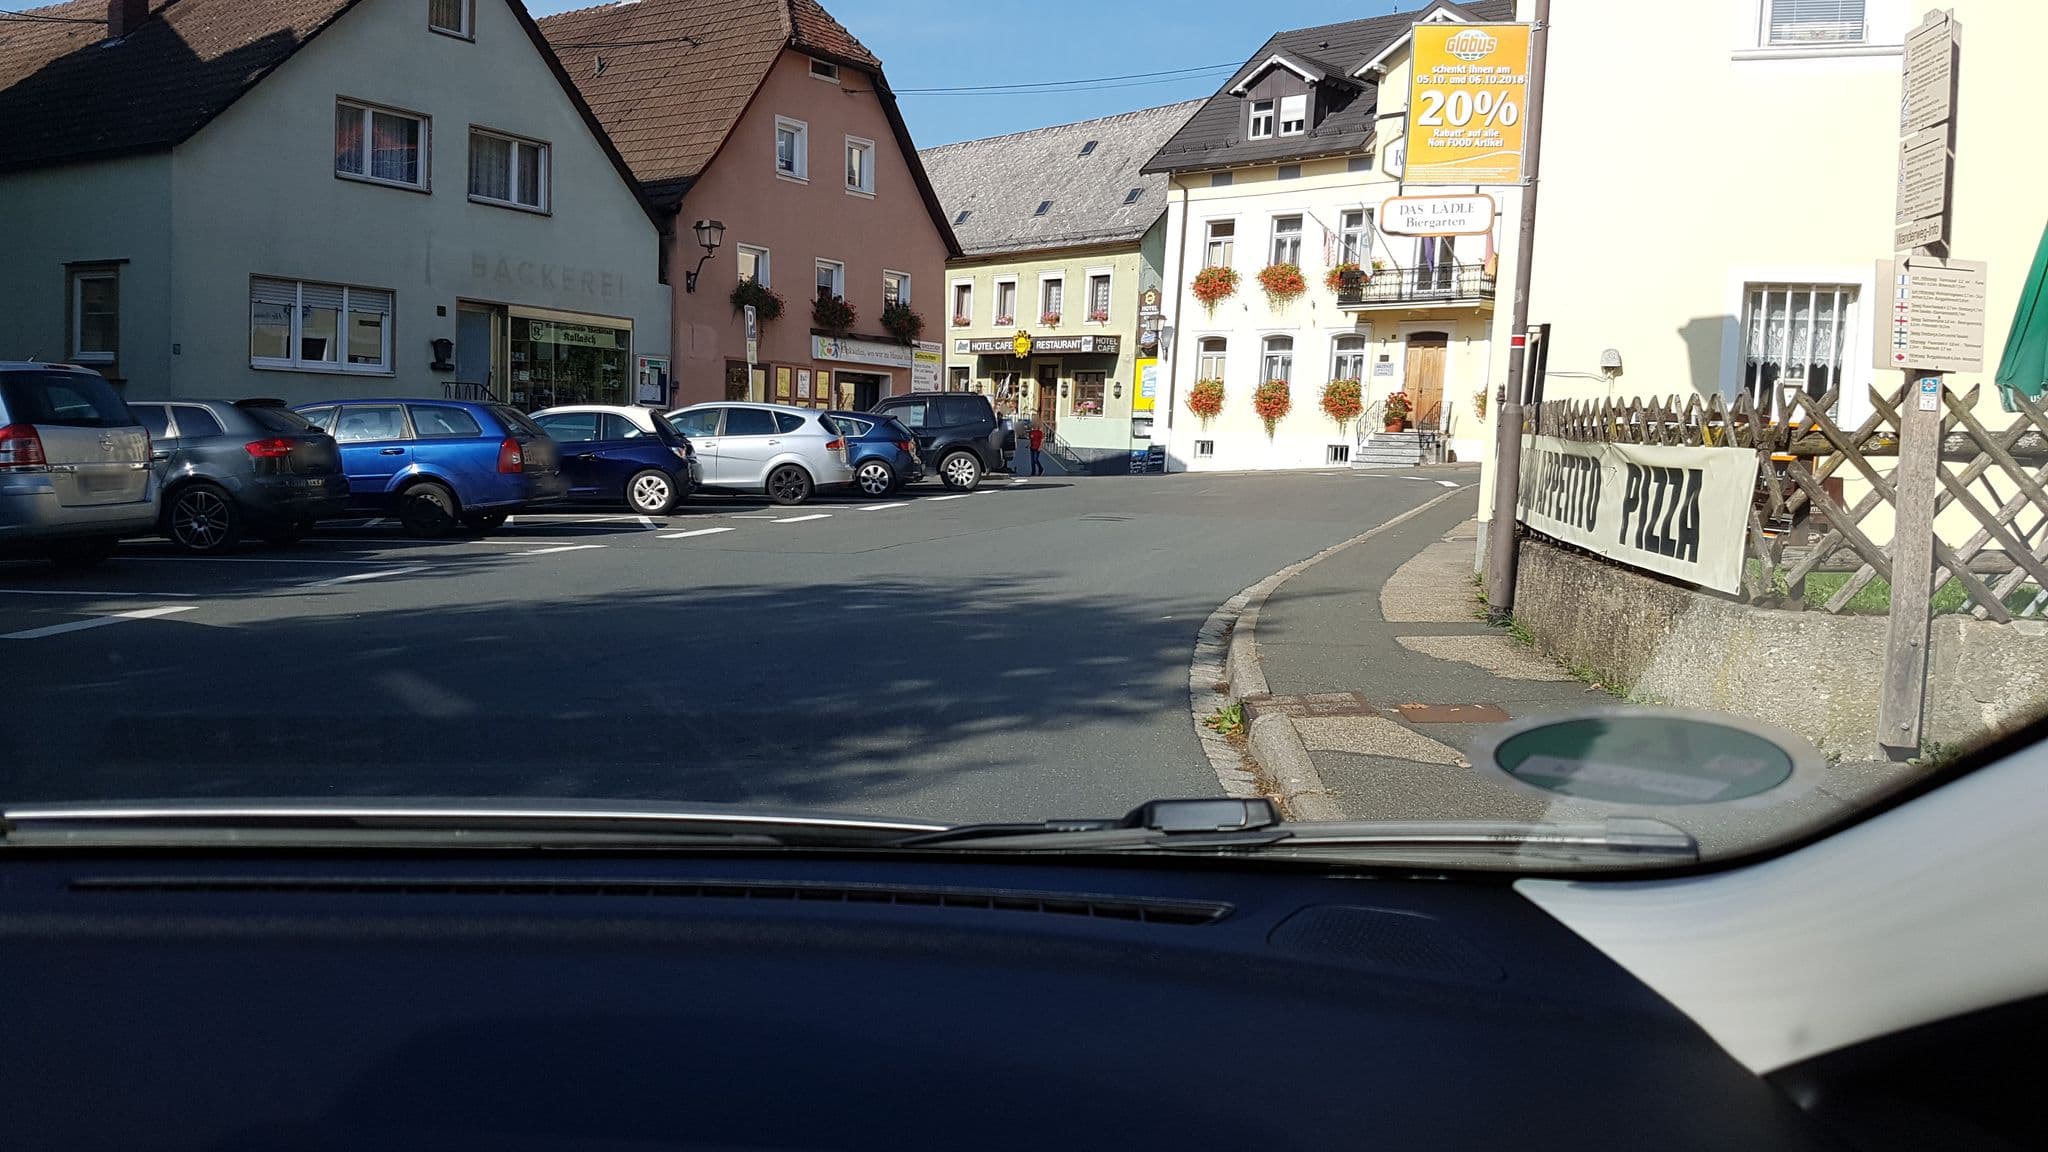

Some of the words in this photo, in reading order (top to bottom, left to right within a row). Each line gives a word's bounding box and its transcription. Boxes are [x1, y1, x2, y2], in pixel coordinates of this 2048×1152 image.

[1432, 64, 1466, 74] schenkt
[1468, 64, 1494, 74] Ihnen
[1496, 66, 1511, 74] am
[1416, 75, 1448, 84] 05.10.
[1450, 75, 1466, 84] und
[1468, 75, 1525, 85] 06.10.2018
[1418, 89, 1519, 127] 20%
[1467, 129, 1482, 138] auf
[1483, 129, 1500, 138] alle
[1427, 139, 1446, 147] Non
[1447, 139, 1472, 148] FOOD
[1474, 138, 1504, 148] Artikel
[1400, 205, 1424, 215] DAS
[1432, 201, 1476, 215] LÄDLE
[1406, 217, 1466, 228] Biergarten
[747, 310, 755, 336] P
[1036, 339, 1082, 349] RESTAURANT
[1095, 337, 1118, 345] HOTEL
[1535, 449, 1601, 533] APPETITO
[1618, 462, 1704, 564] PIZZA
